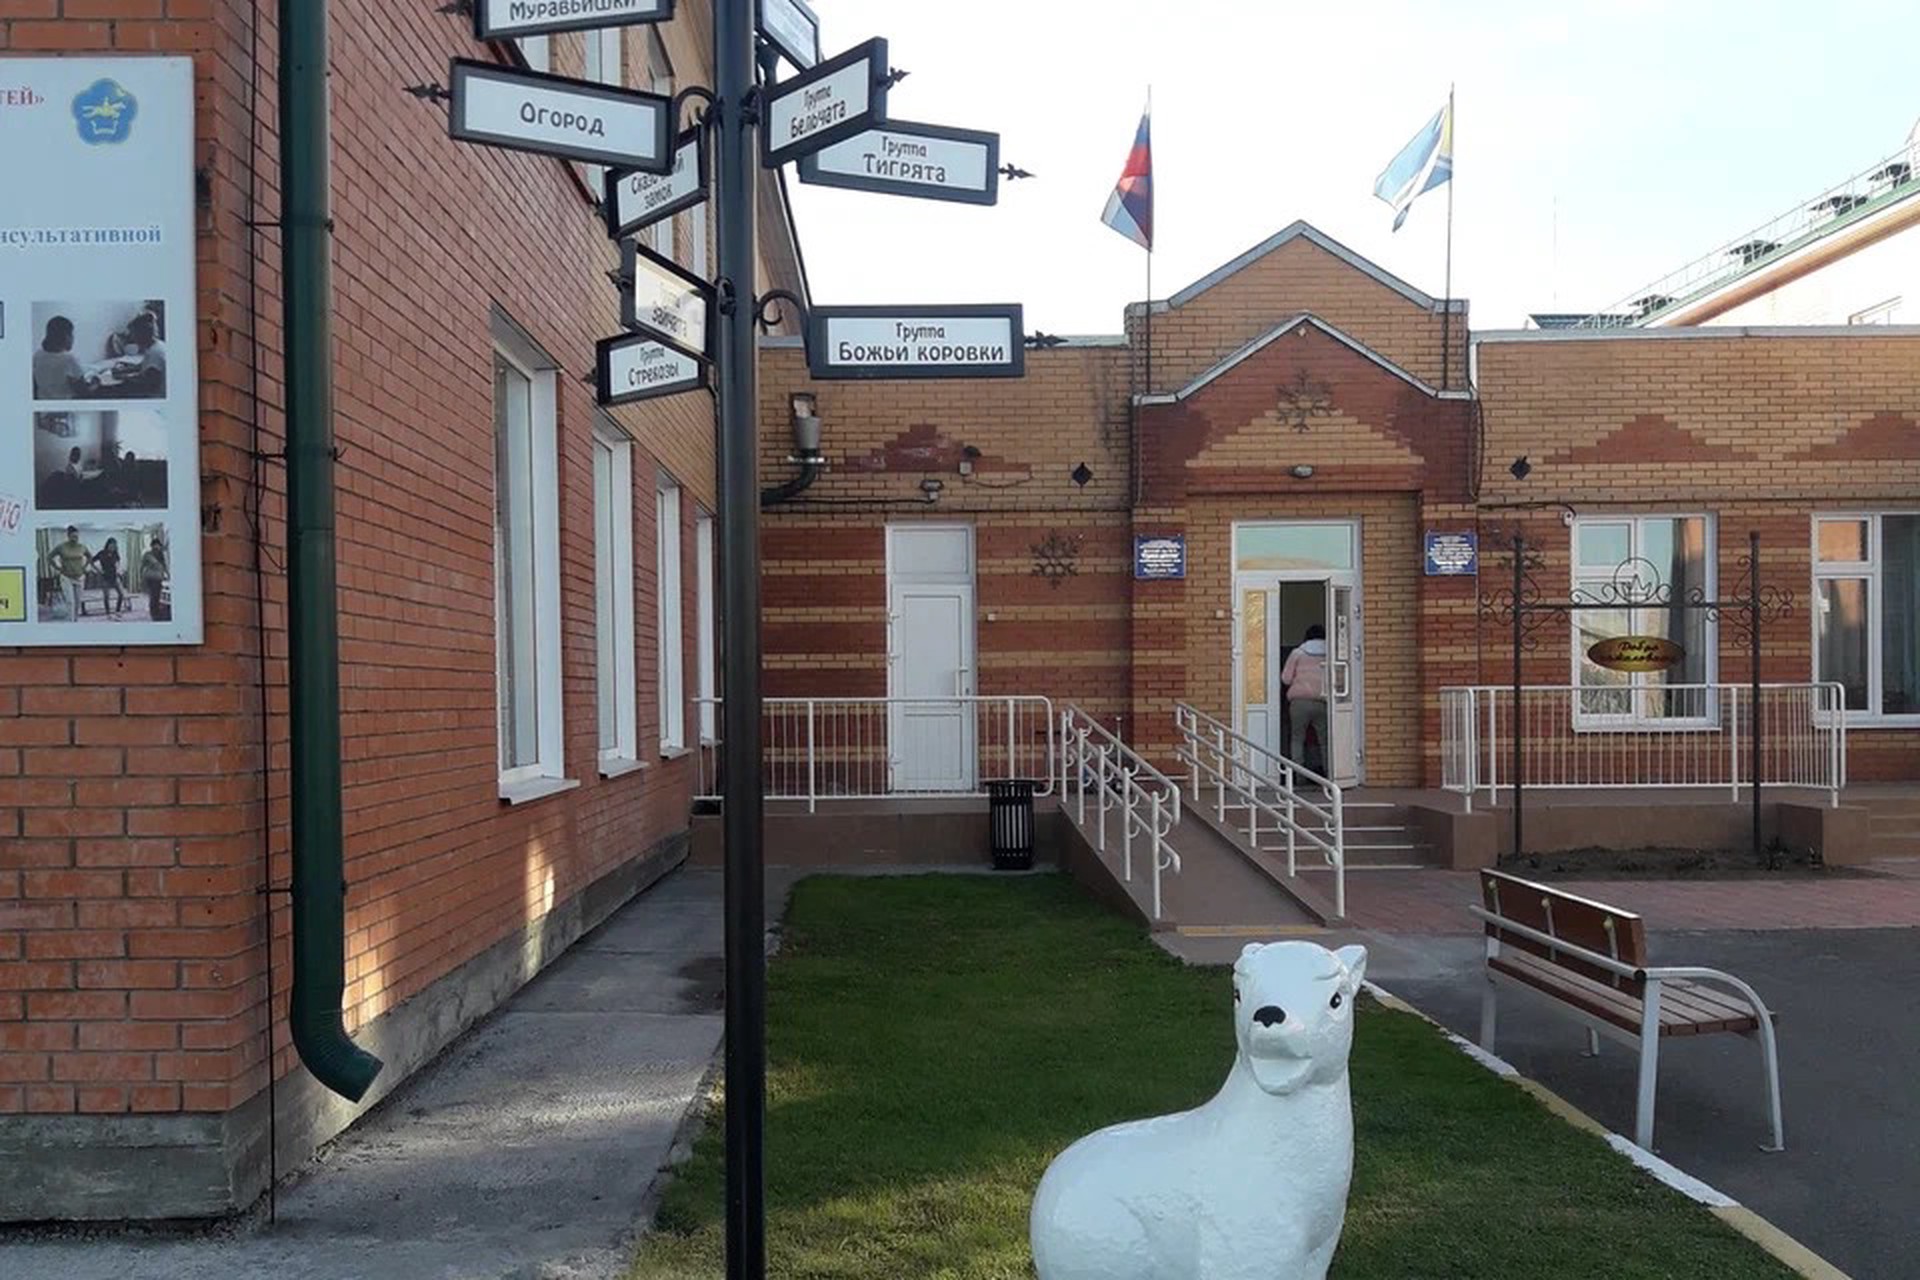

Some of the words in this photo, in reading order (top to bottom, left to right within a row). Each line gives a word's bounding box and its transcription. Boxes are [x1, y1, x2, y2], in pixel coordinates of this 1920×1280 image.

[804, 86, 832, 110] Группа
[520, 101, 606, 137] Огород
[791, 100, 846, 138] Бельчата
[882, 136, 928, 158] Группа
[863, 153, 946, 183] Тигрята
[895, 322, 946, 342] Группа
[839, 341, 910, 362] Божьи
[917, 345, 1004, 362] коровки
[628, 361, 679, 387] Стрекозы
